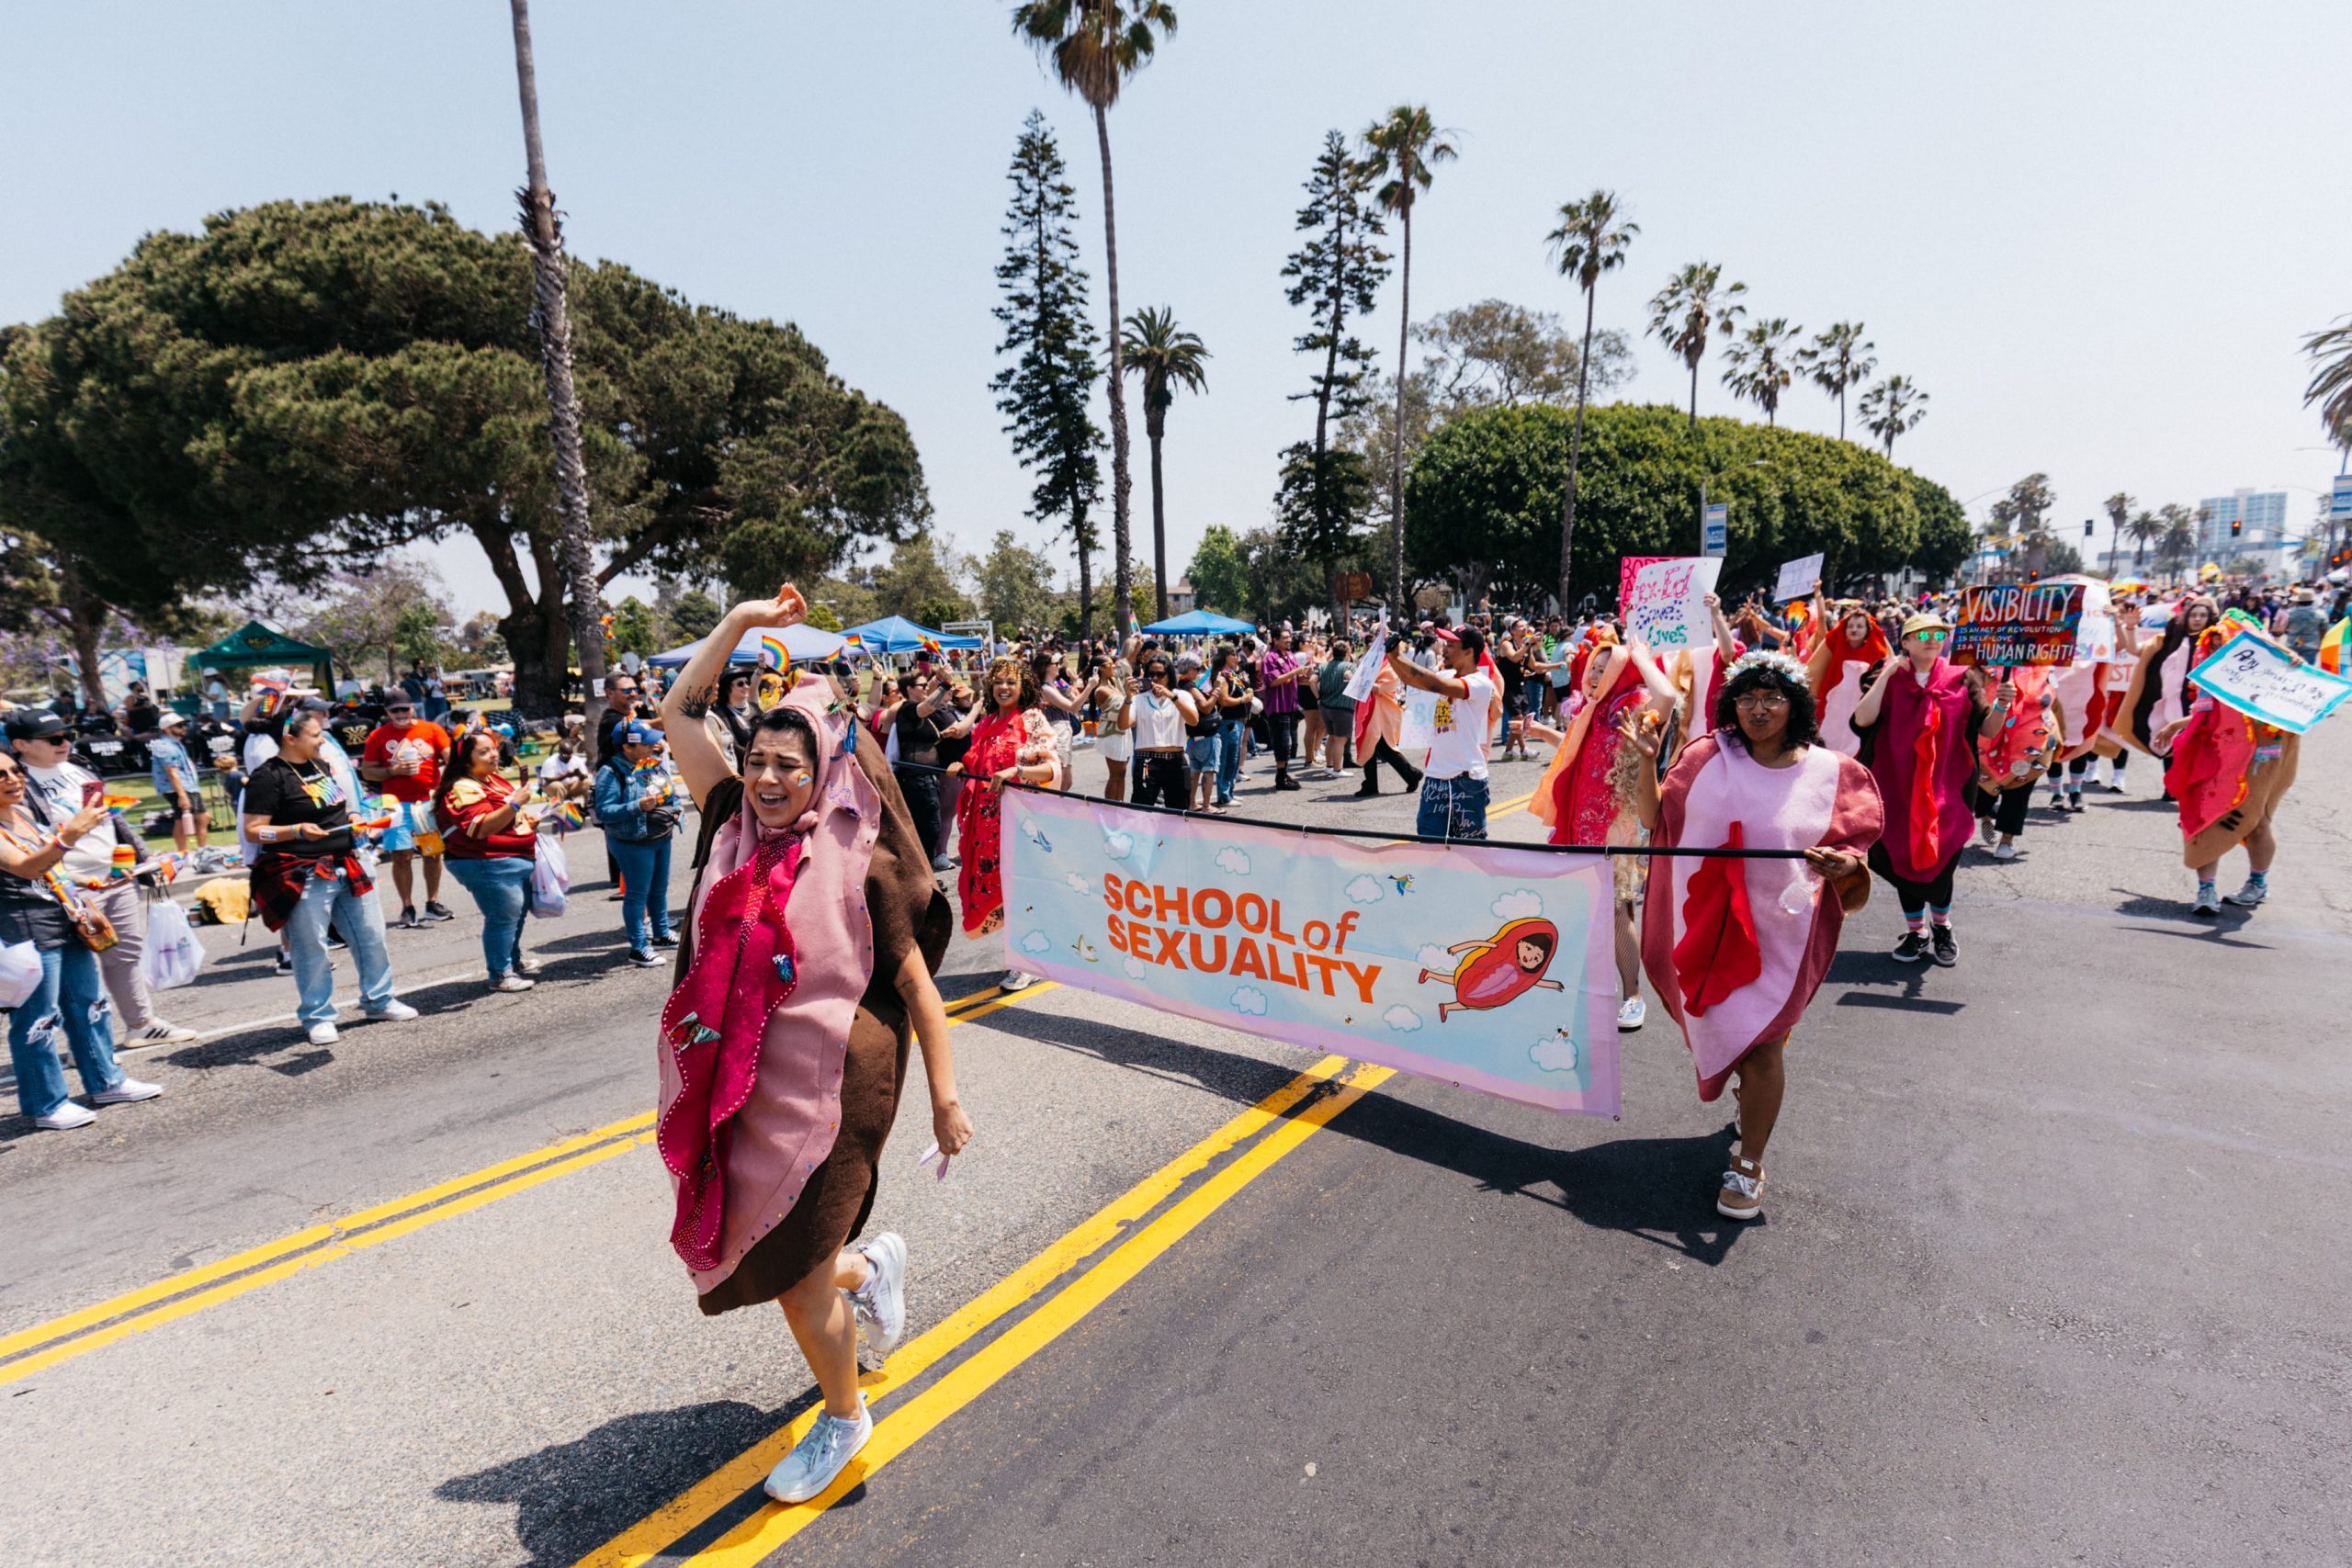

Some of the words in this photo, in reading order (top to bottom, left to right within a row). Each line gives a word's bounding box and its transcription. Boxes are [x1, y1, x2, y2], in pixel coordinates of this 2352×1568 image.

[1965, 586, 2076, 623] VISIBILITY
[2007, 626, 2062, 634] REVOLUTION
[1975, 644, 2025, 660] HUMAN
[2027, 644, 2075, 660] RIGHT!
[1103, 872, 1297, 946] SCHOOL
[1303, 909, 1360, 955] of
[1107, 913, 1382, 1004] SEXUALITY
